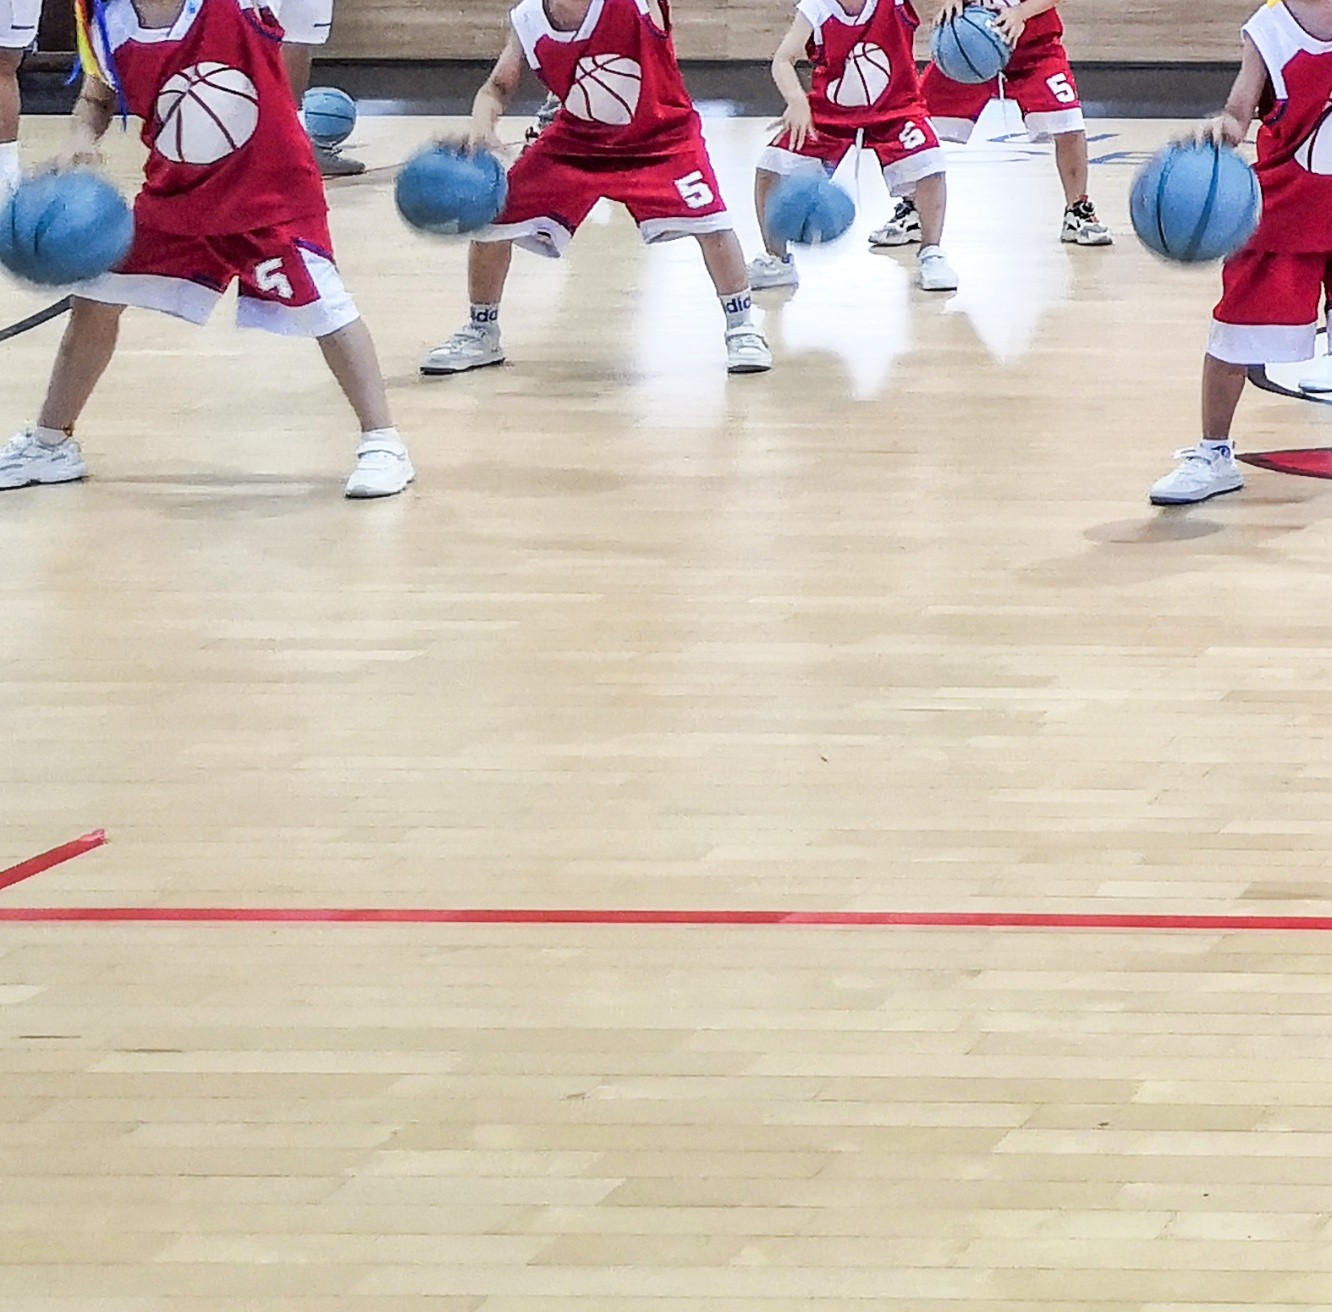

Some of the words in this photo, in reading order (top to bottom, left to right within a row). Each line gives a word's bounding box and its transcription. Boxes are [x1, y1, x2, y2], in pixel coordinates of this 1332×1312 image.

[1045, 73, 1077, 104] 5
[674, 170, 715, 210] 5
[255, 257, 294, 300] 5
